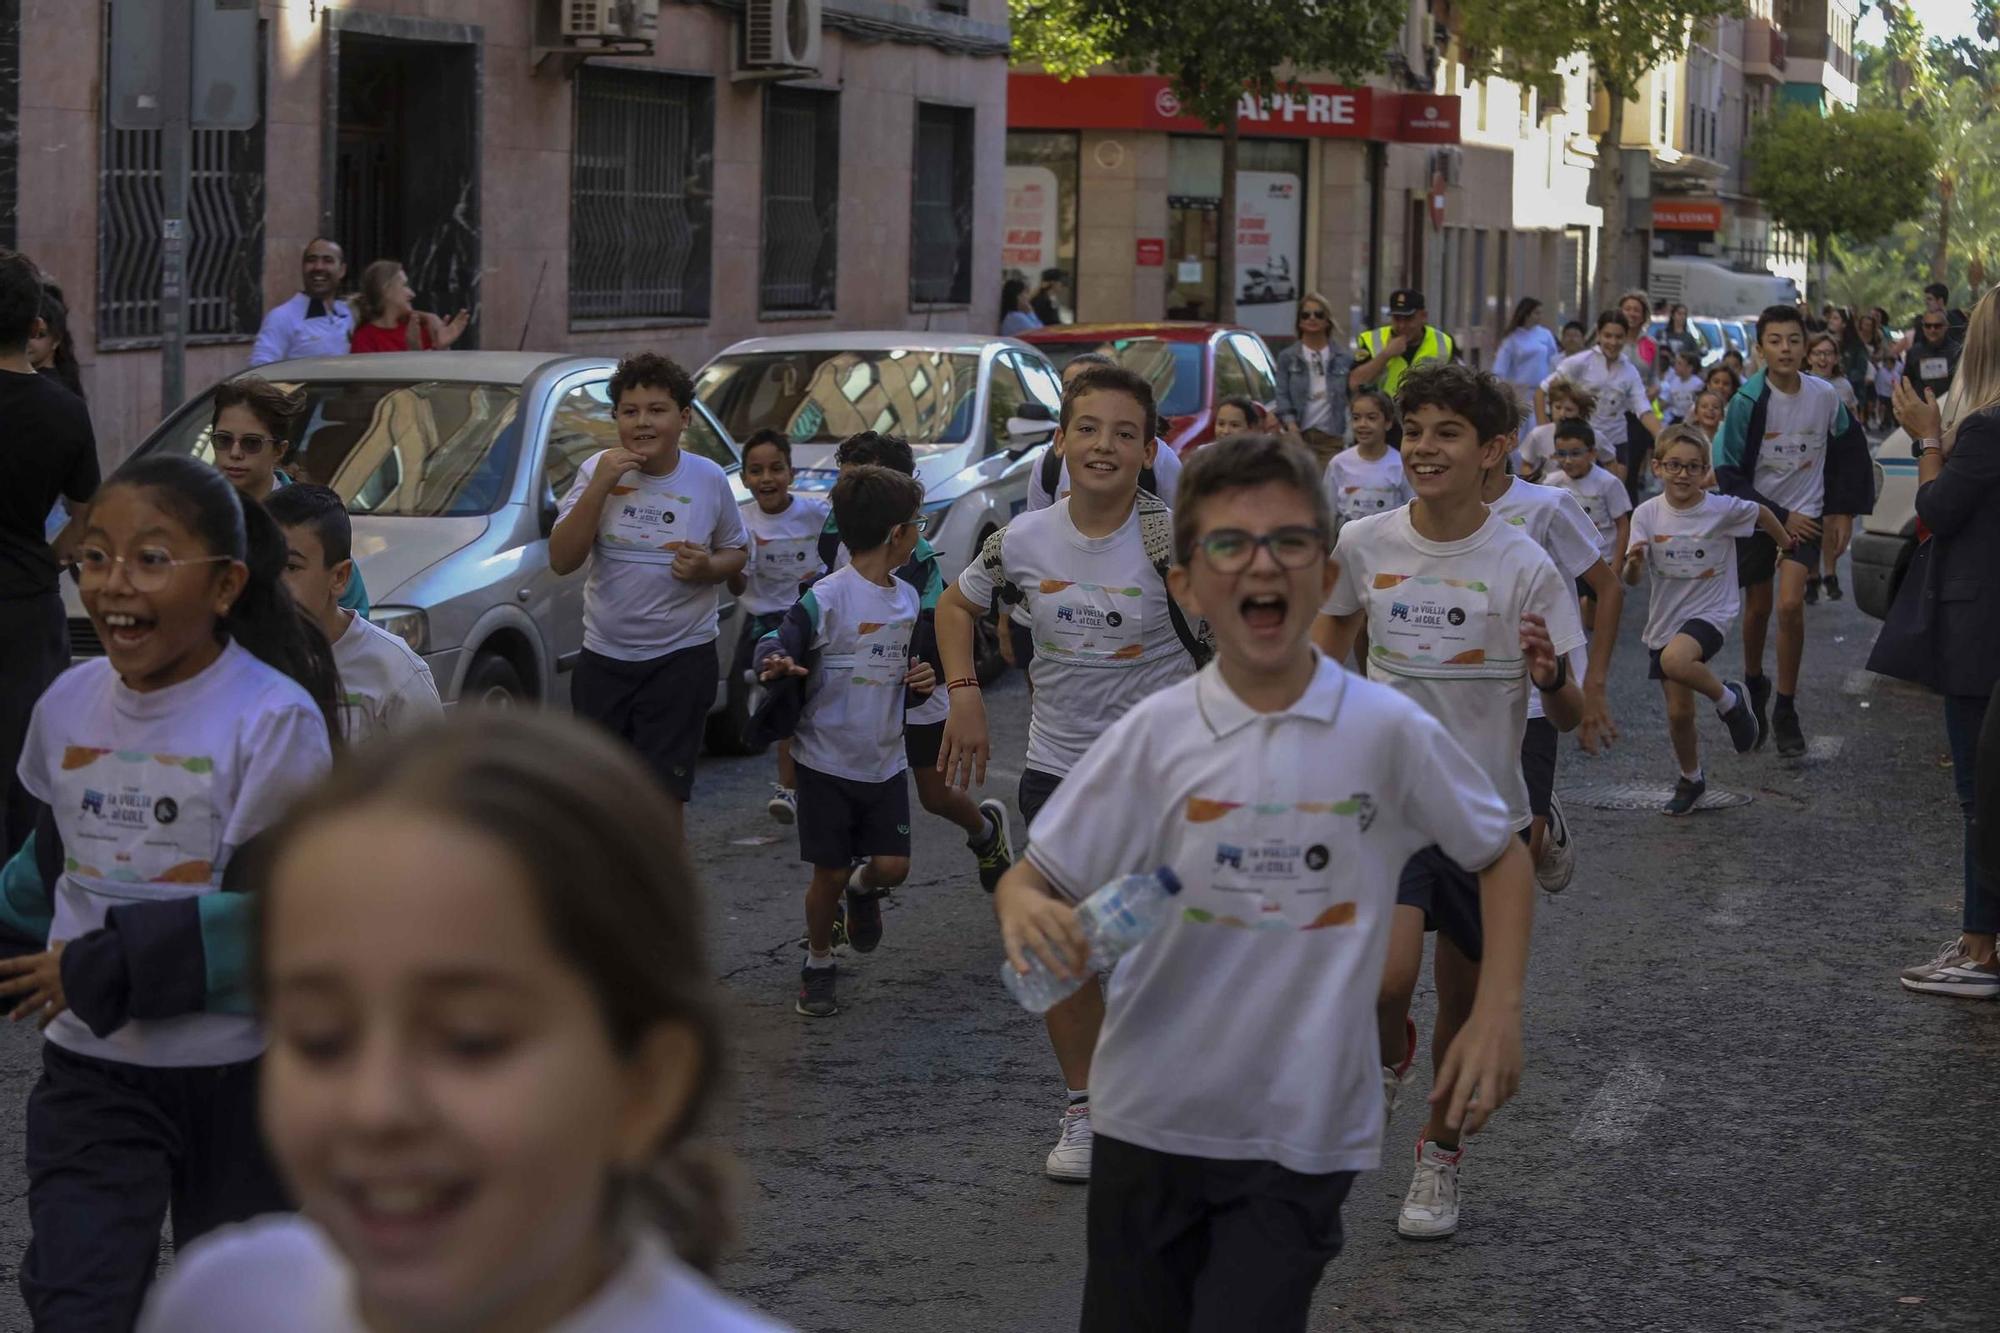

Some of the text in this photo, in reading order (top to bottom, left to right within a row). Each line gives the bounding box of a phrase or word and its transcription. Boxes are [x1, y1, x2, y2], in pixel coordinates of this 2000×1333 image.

[1237, 91, 1355, 125] APFRE
[1083, 608, 1105, 618] VUELTA
[1420, 605, 1446, 616] VUELTA
[1086, 618, 1101, 626] COLE
[1422, 615, 1441, 625] COLE
